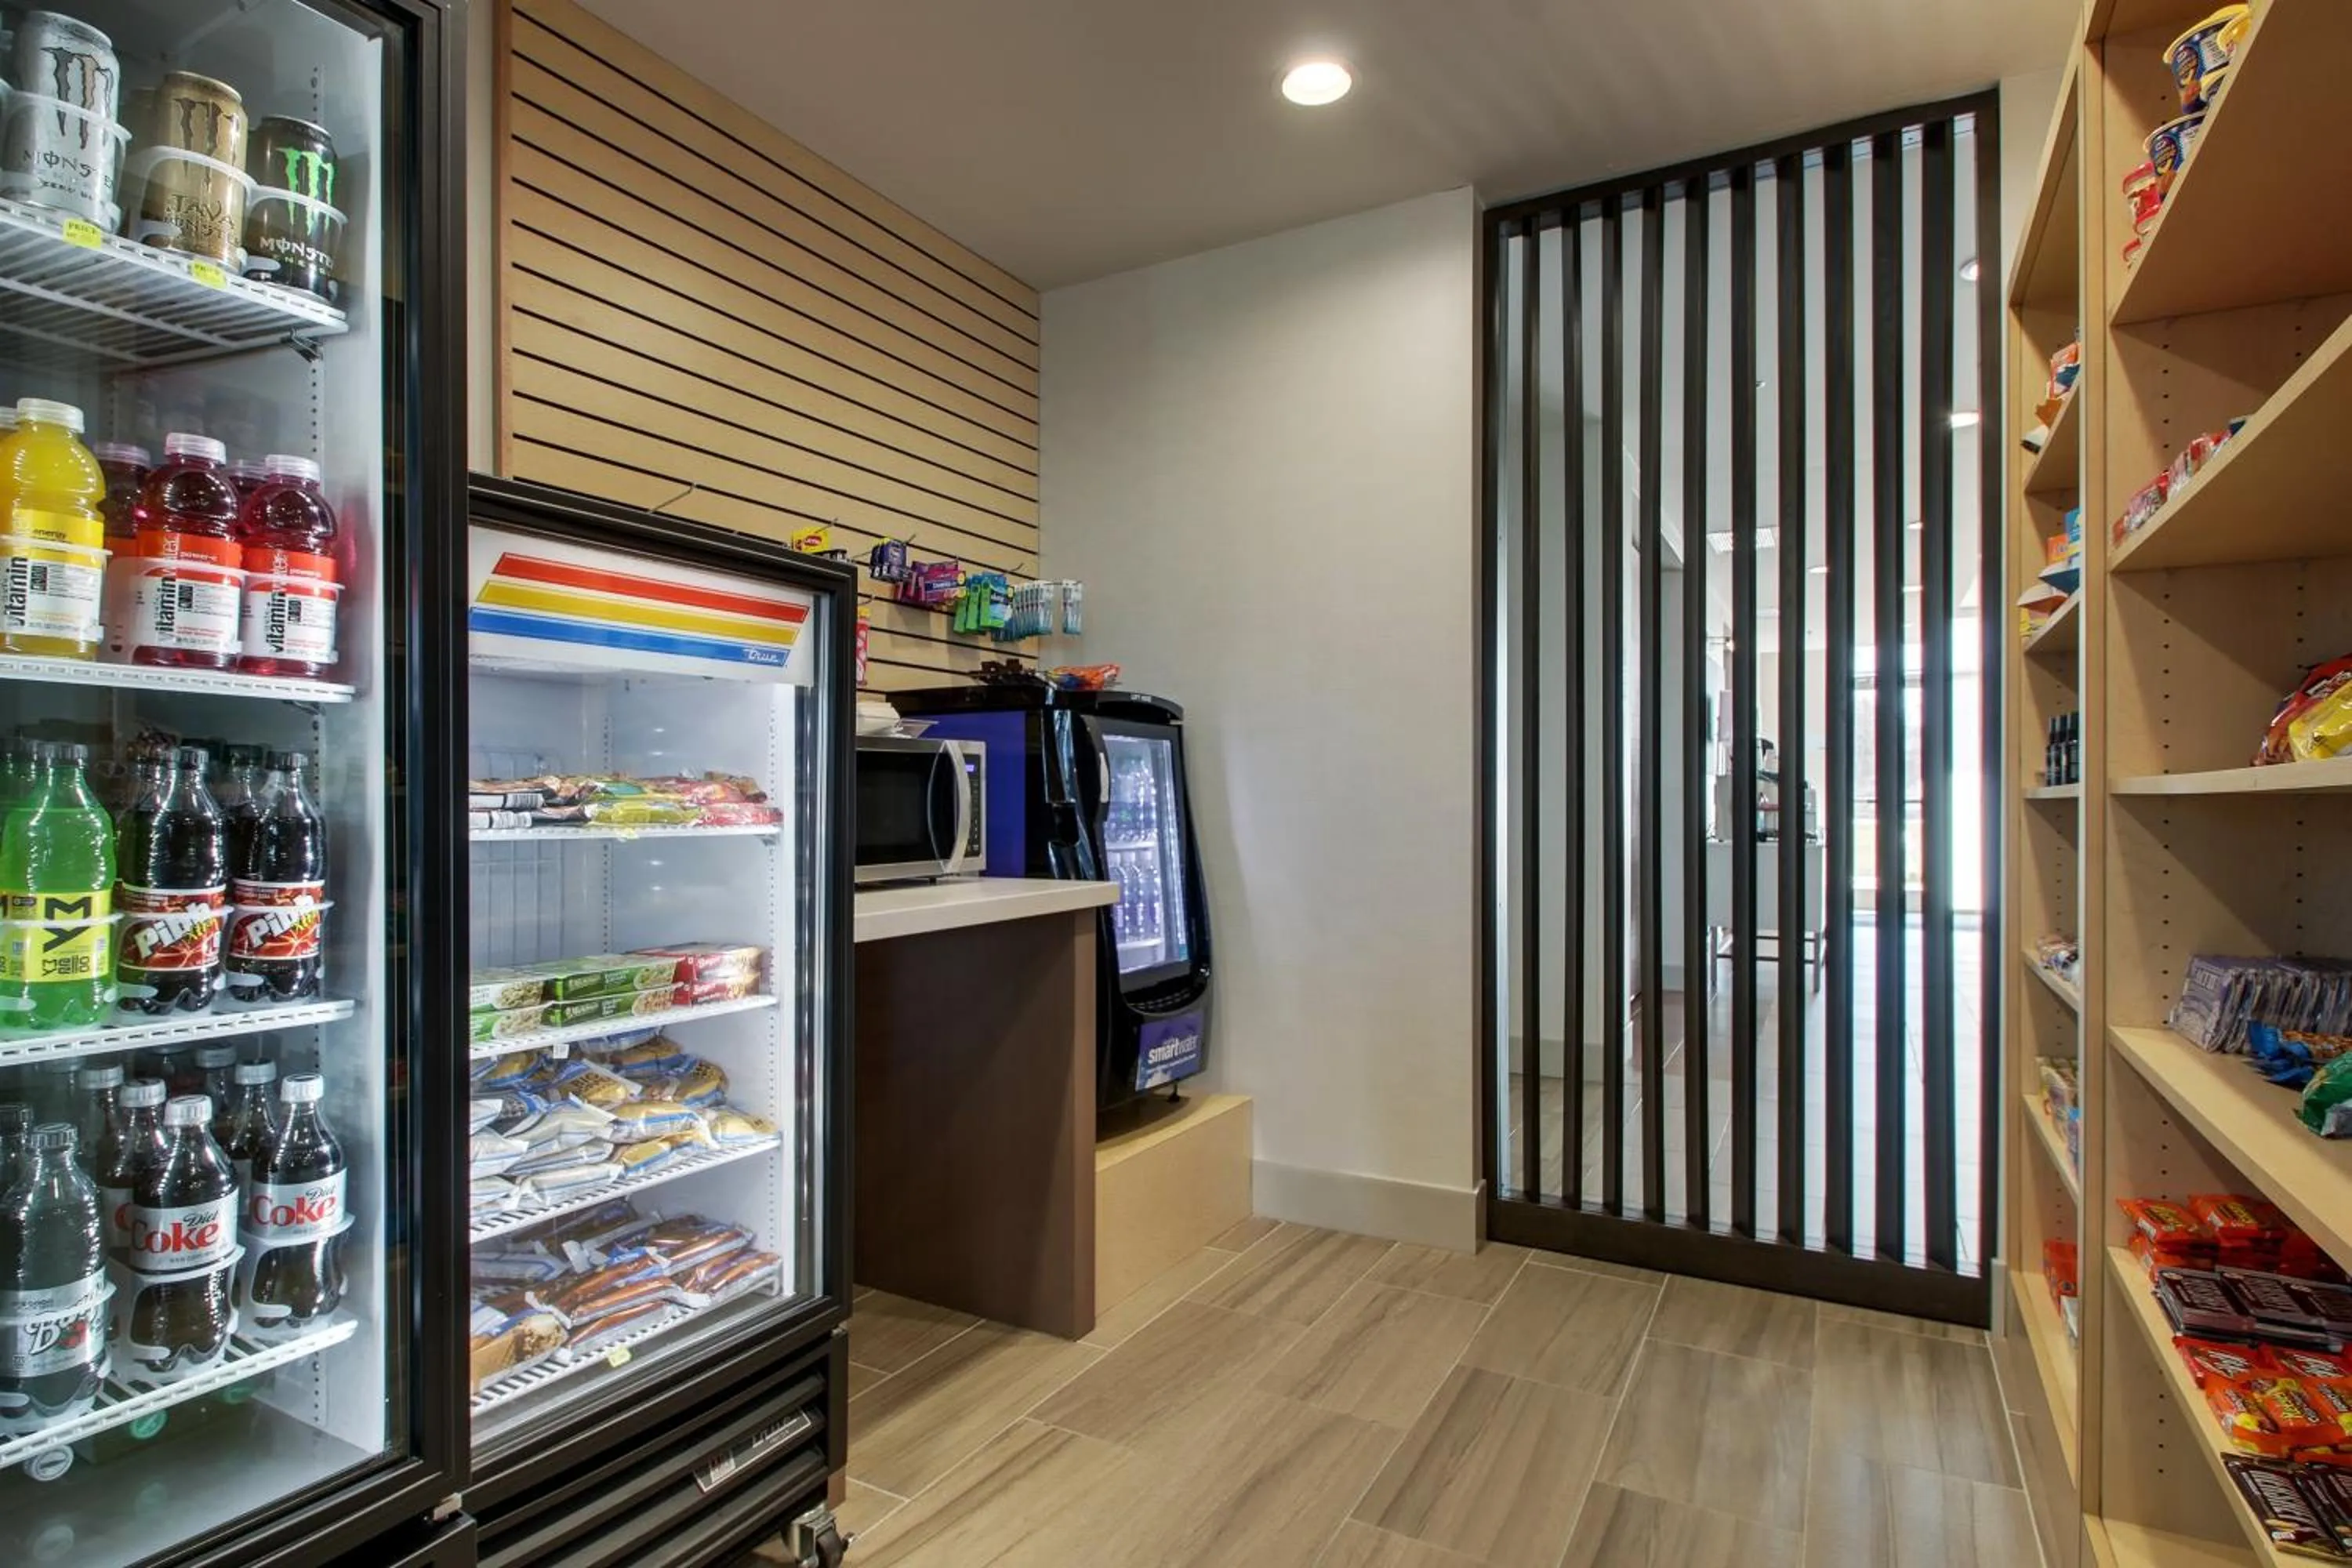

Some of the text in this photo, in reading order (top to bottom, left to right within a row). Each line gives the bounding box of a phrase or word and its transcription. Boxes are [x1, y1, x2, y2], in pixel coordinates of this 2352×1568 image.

[183, 1210, 219, 1227] Diet
[253, 1195, 337, 1227] Coke
[131, 1218, 219, 1254] Coke
